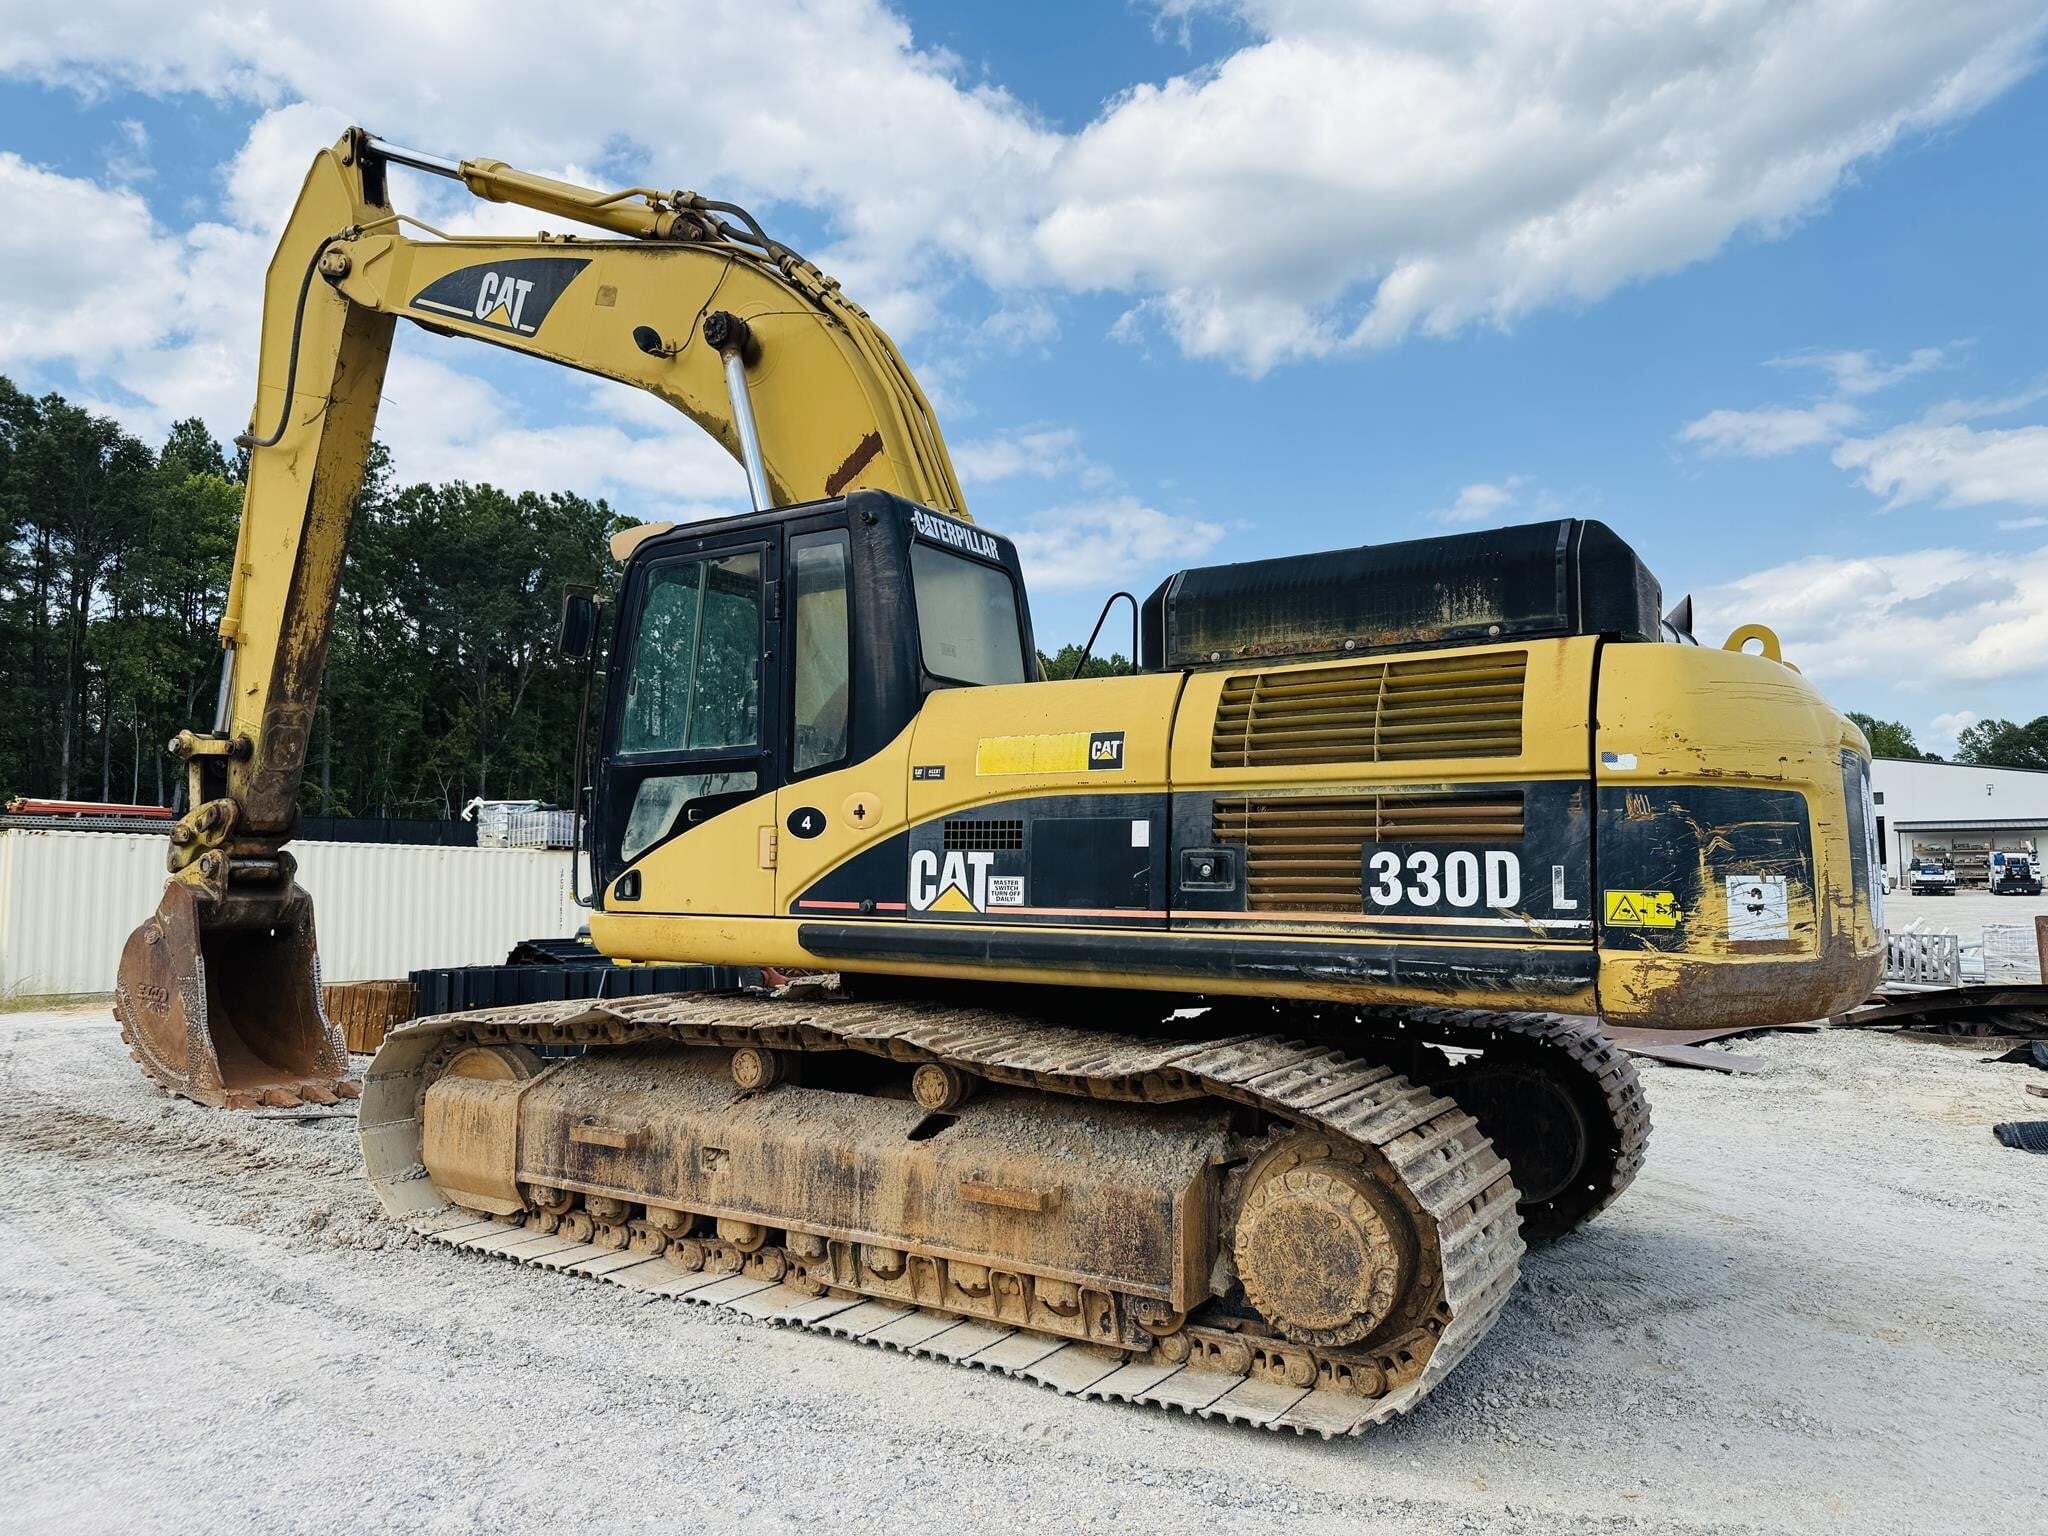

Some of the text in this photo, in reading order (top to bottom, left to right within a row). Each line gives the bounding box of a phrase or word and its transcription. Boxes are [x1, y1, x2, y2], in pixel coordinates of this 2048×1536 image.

[475, 272, 533, 328] CAT
[913, 510, 1000, 560] CATERPILLAR
[1091, 740, 1120, 760] CAT
[801, 815, 812, 830] 4
[910, 849, 995, 913] CAT
[1369, 850, 1577, 909] 330D L
